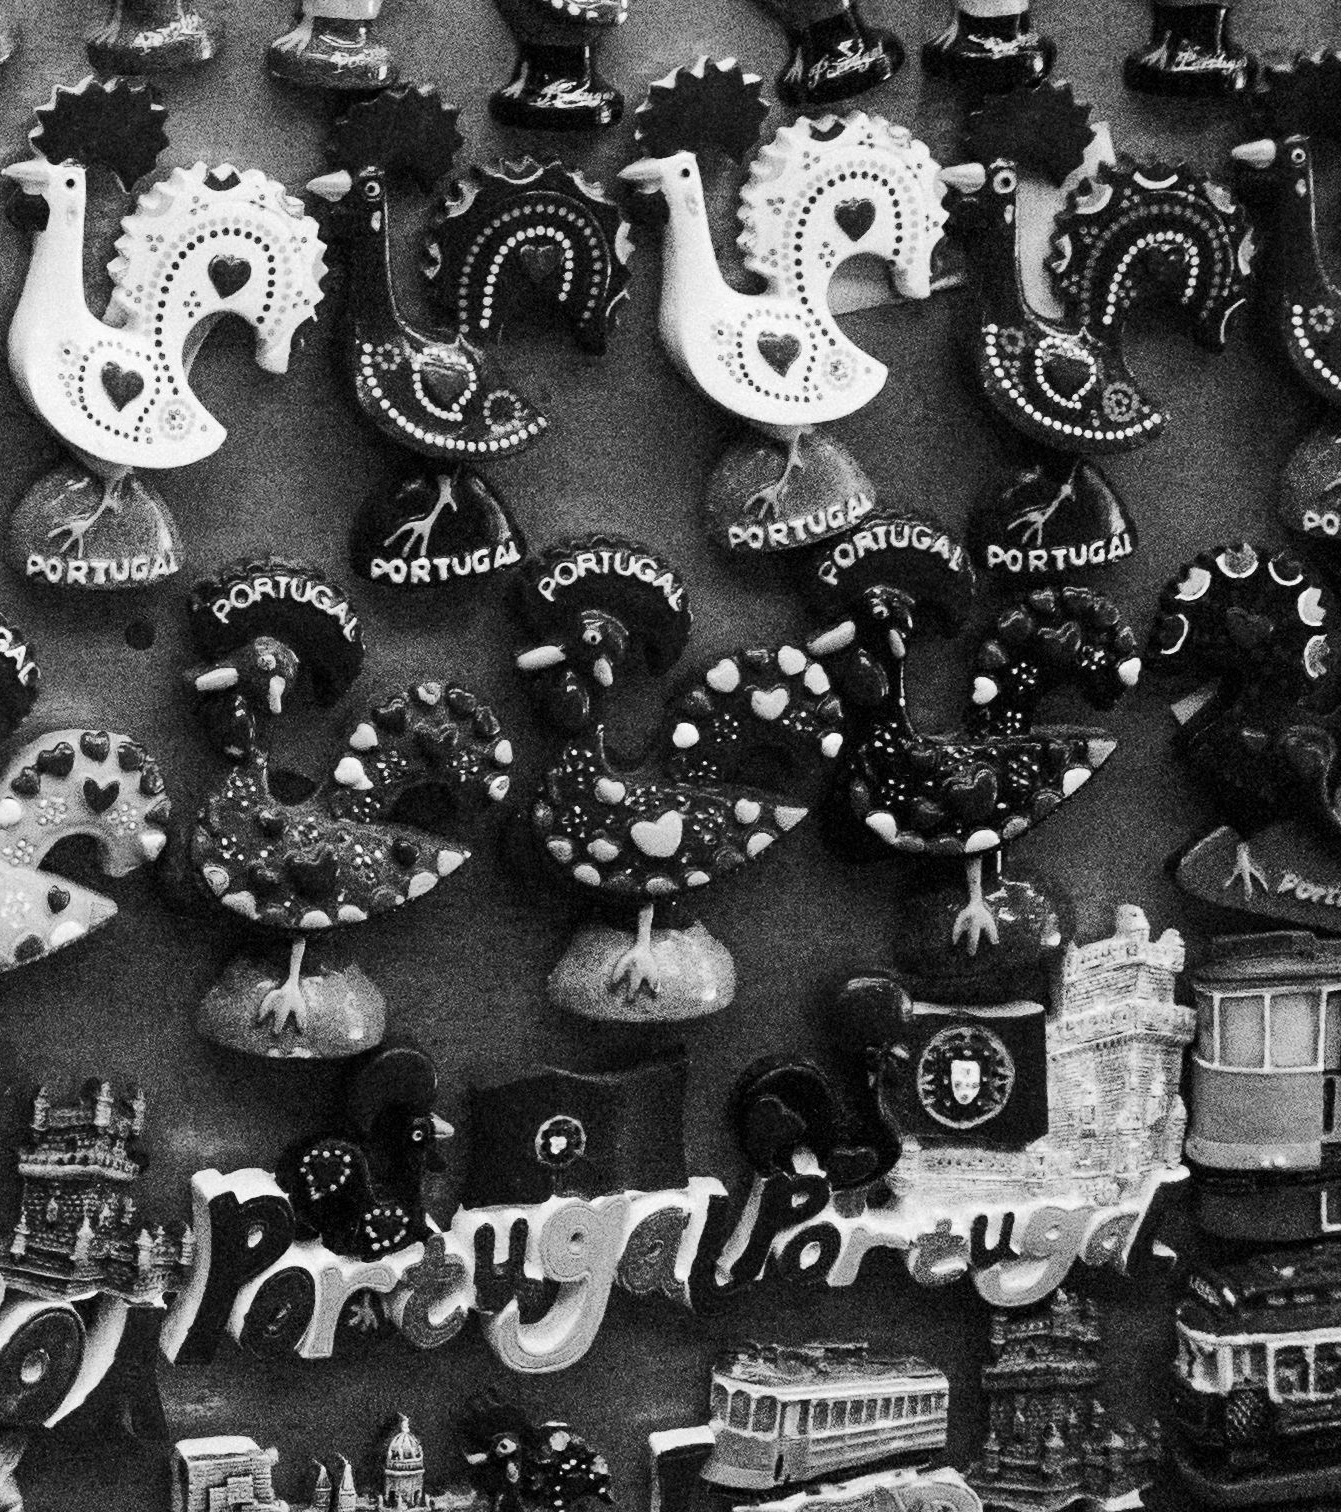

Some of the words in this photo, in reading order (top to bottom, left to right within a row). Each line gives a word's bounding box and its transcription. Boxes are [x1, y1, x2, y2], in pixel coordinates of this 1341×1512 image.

[20, 543, 187, 583] PORTUGAL
[369, 542, 520, 583] PORTUGAL
[986, 537, 1146, 572] PORTUGAL
[535, 547, 688, 609] PORTUGAL
[210, 574, 366, 641] PORTUGAL
